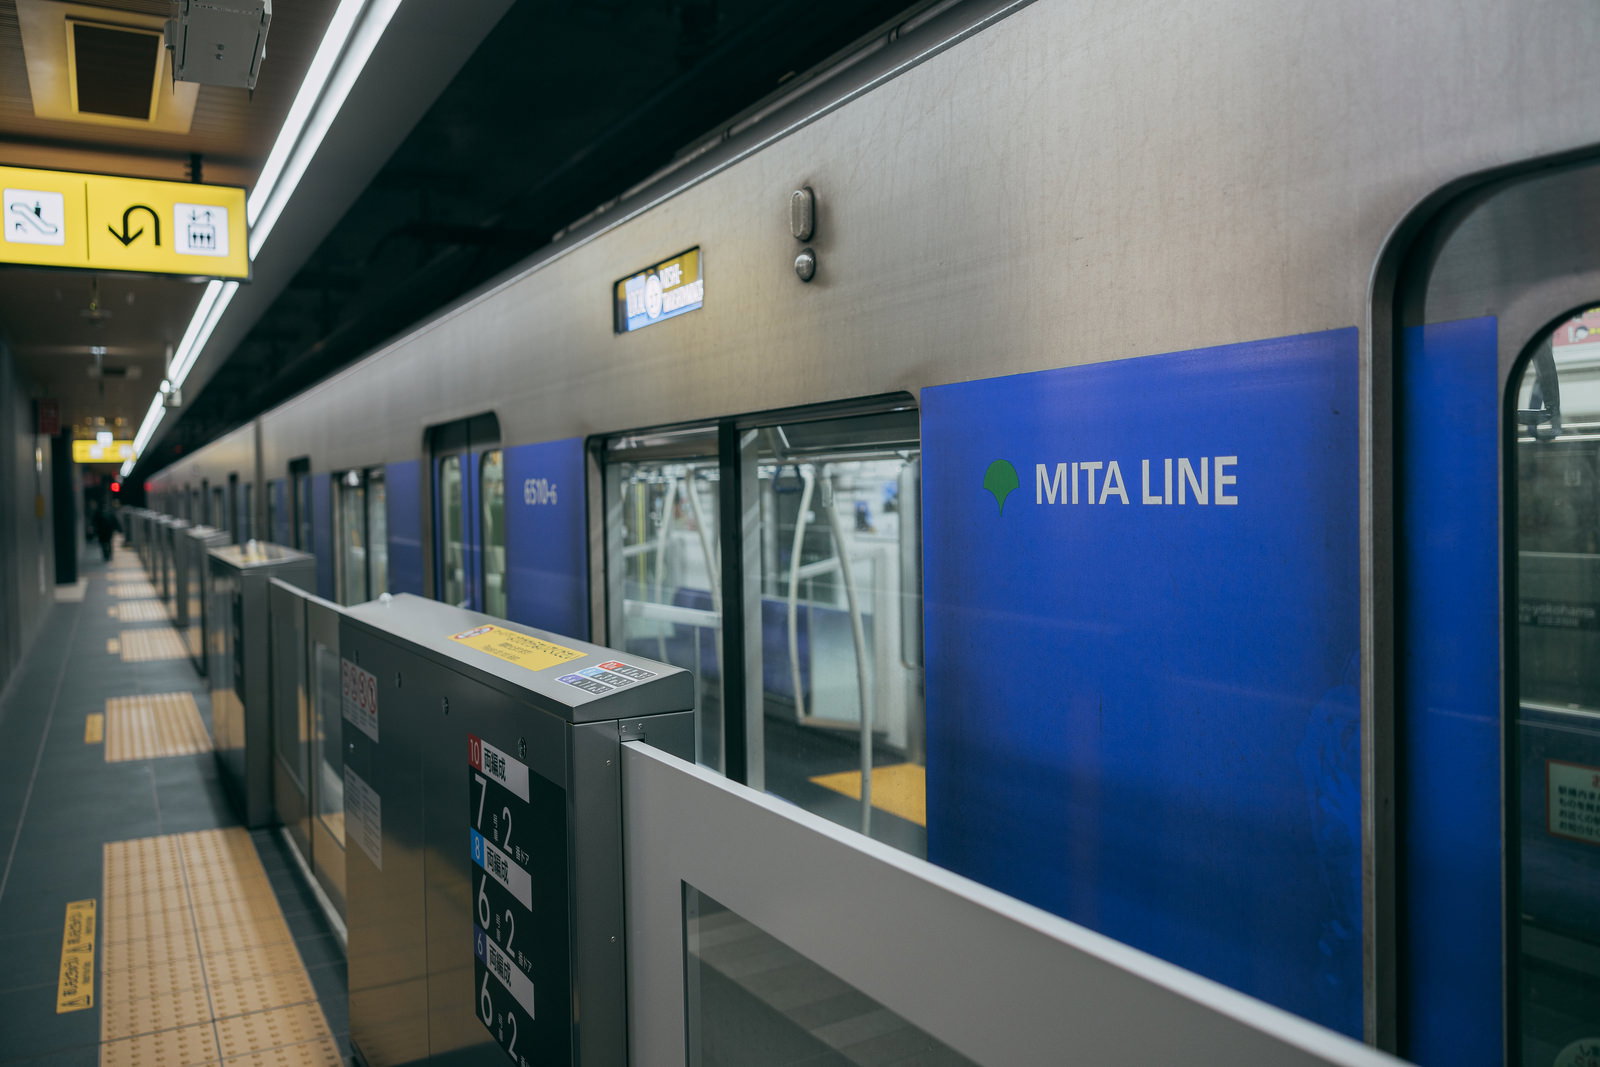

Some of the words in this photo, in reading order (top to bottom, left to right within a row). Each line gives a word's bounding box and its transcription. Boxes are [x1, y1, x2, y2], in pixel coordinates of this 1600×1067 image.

[524, 478, 558, 505] 6510-6
[1036, 460, 1130, 505] MITA
[1142, 455, 1239, 505] LINE
[470, 738, 480, 765] 10
[484, 747, 506, 782] 両編成
[474, 773, 487, 830] 7
[502, 806, 513, 855] 2
[474, 836, 481, 861] 8
[486, 845, 509, 886] 両編成
[478, 873, 490, 930] 6
[505, 908, 516, 959] 2
[477, 932, 483, 955] 6
[488, 943, 512, 988] 両編成
[481, 970, 493, 1027] 6
[508, 1011, 518, 1062] 2
